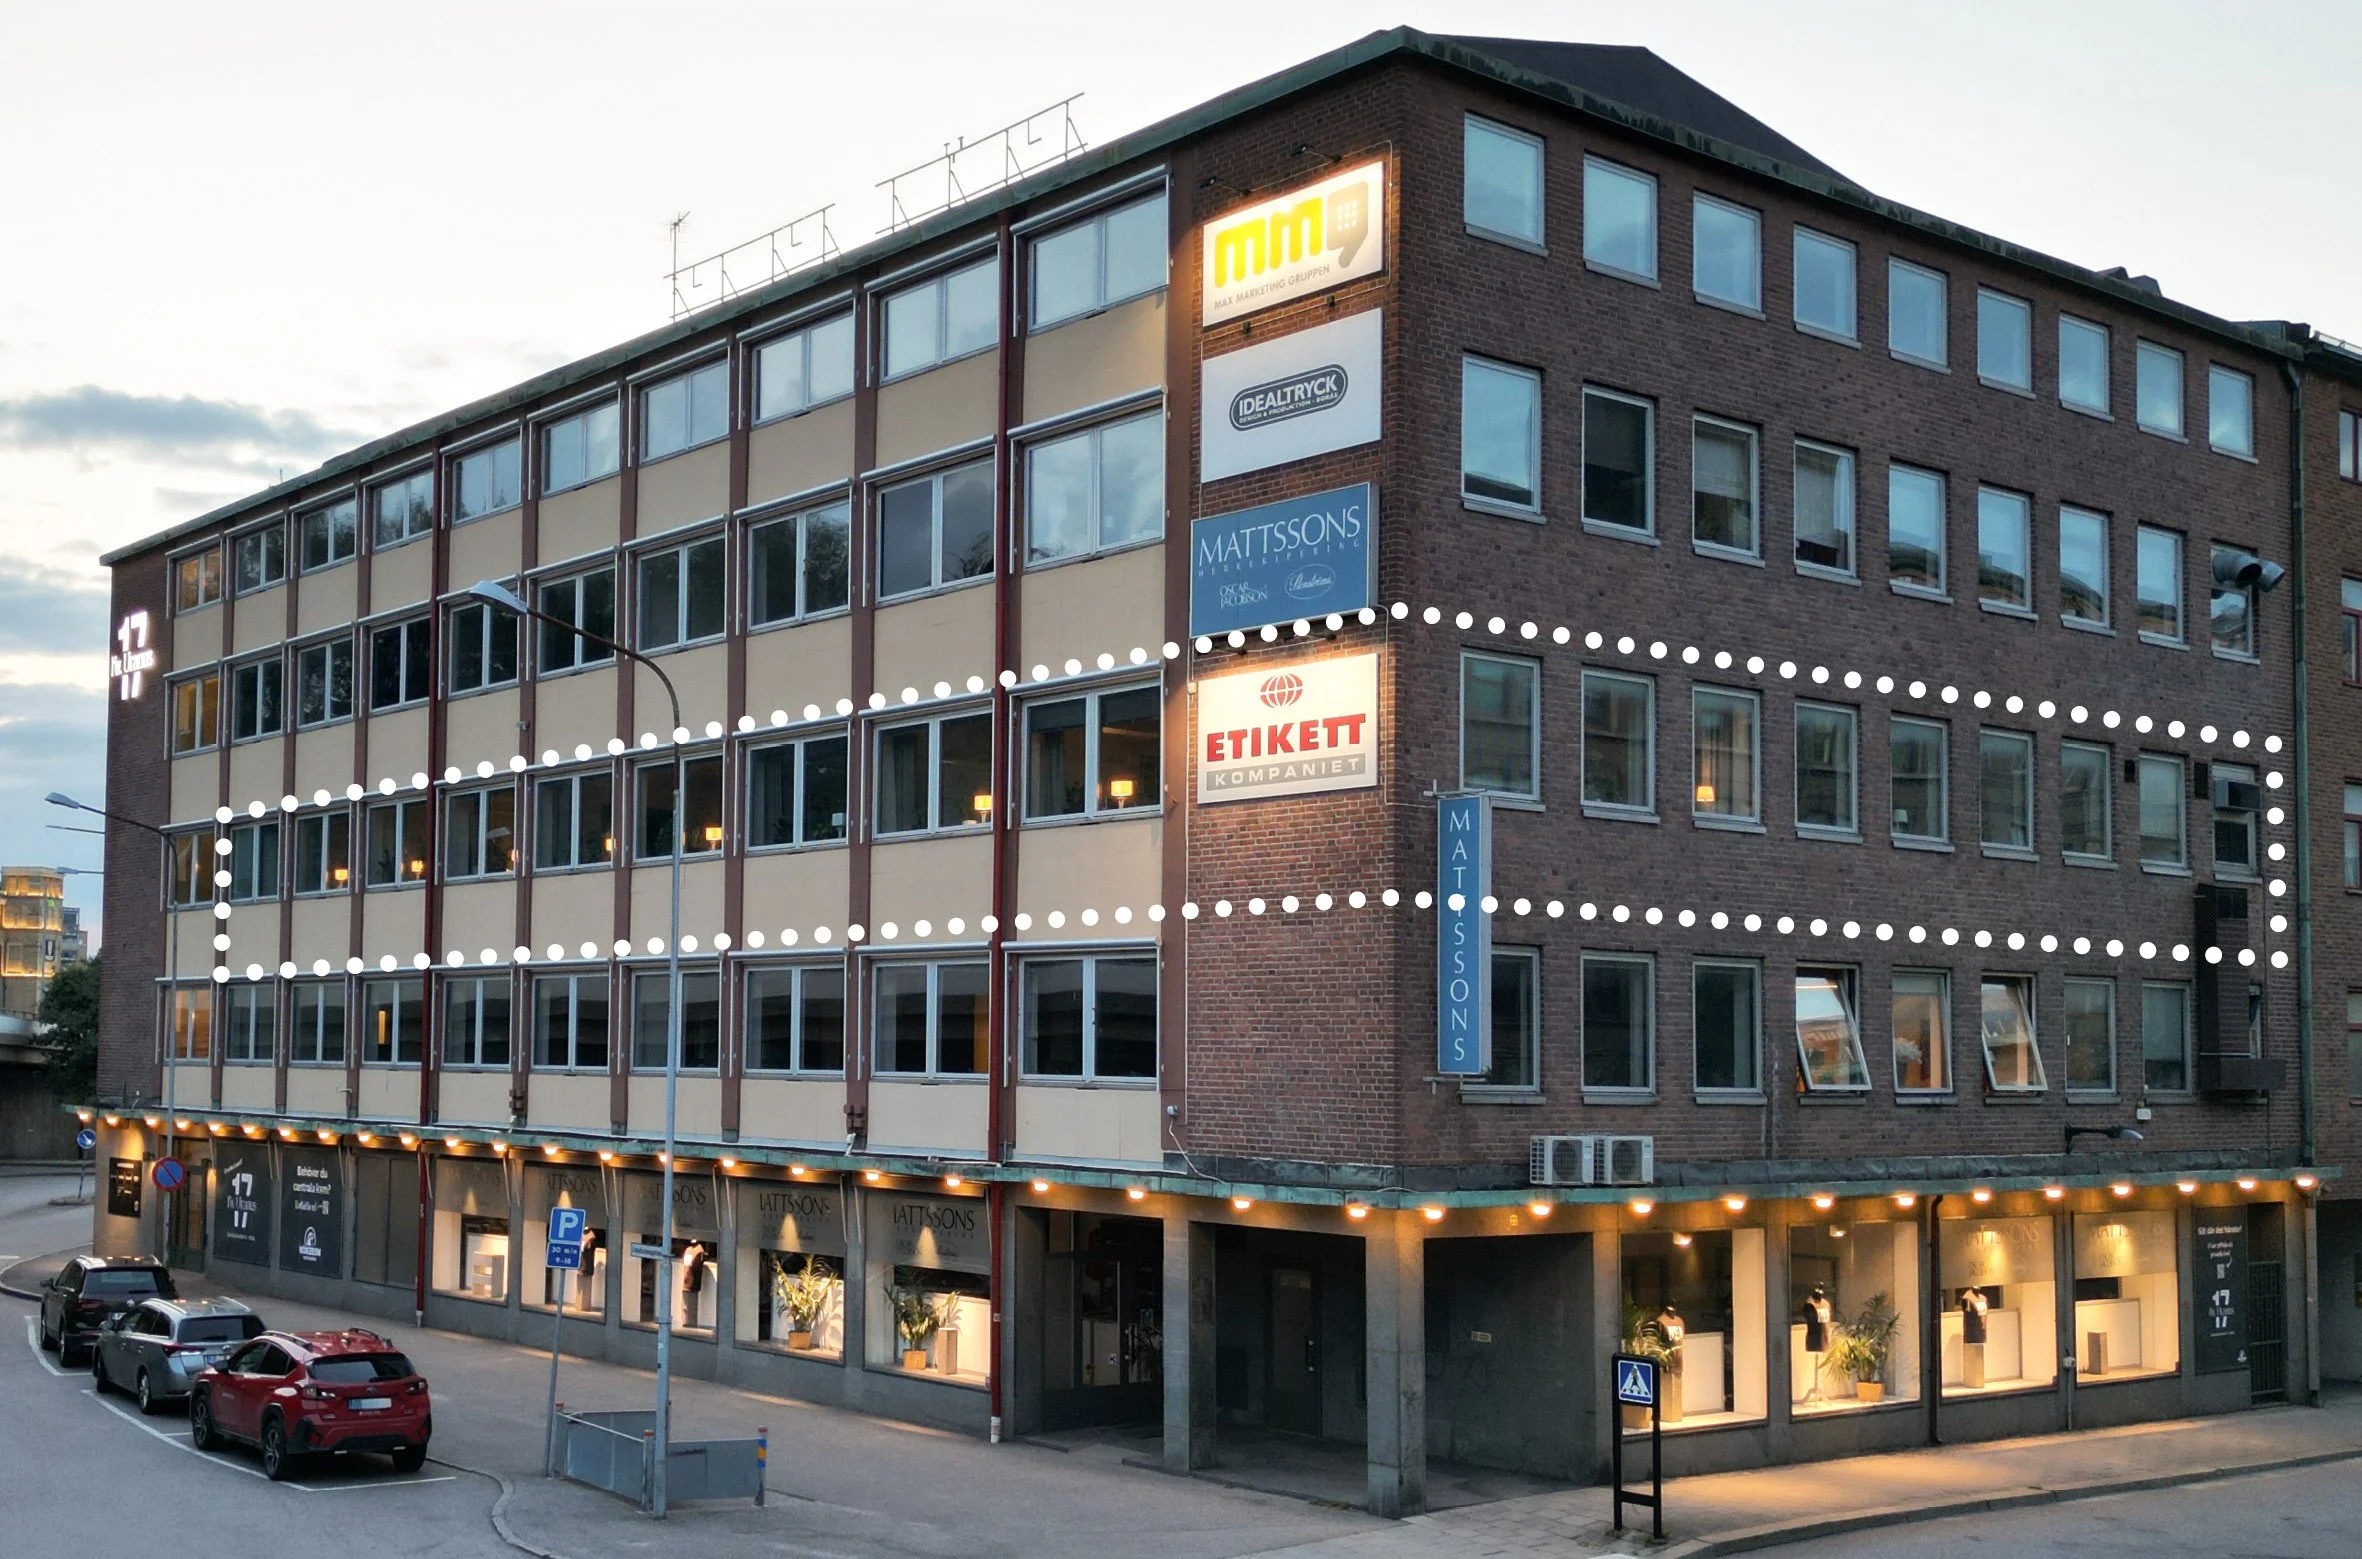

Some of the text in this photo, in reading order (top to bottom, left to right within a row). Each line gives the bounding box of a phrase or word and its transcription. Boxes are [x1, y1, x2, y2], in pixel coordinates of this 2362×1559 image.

[1214, 263, 1331, 310] MAX MARKETING GRUPPEN
[1239, 374, 1338, 416] IDEALTRYCK
[1198, 505, 1361, 567] MATTSSONS
[1219, 580, 1249, 597] OSCAR
[1206, 713, 1366, 763] ETIKETT
[1214, 757, 1361, 787] KOMPANIET
[558, 1211, 579, 1238] P
